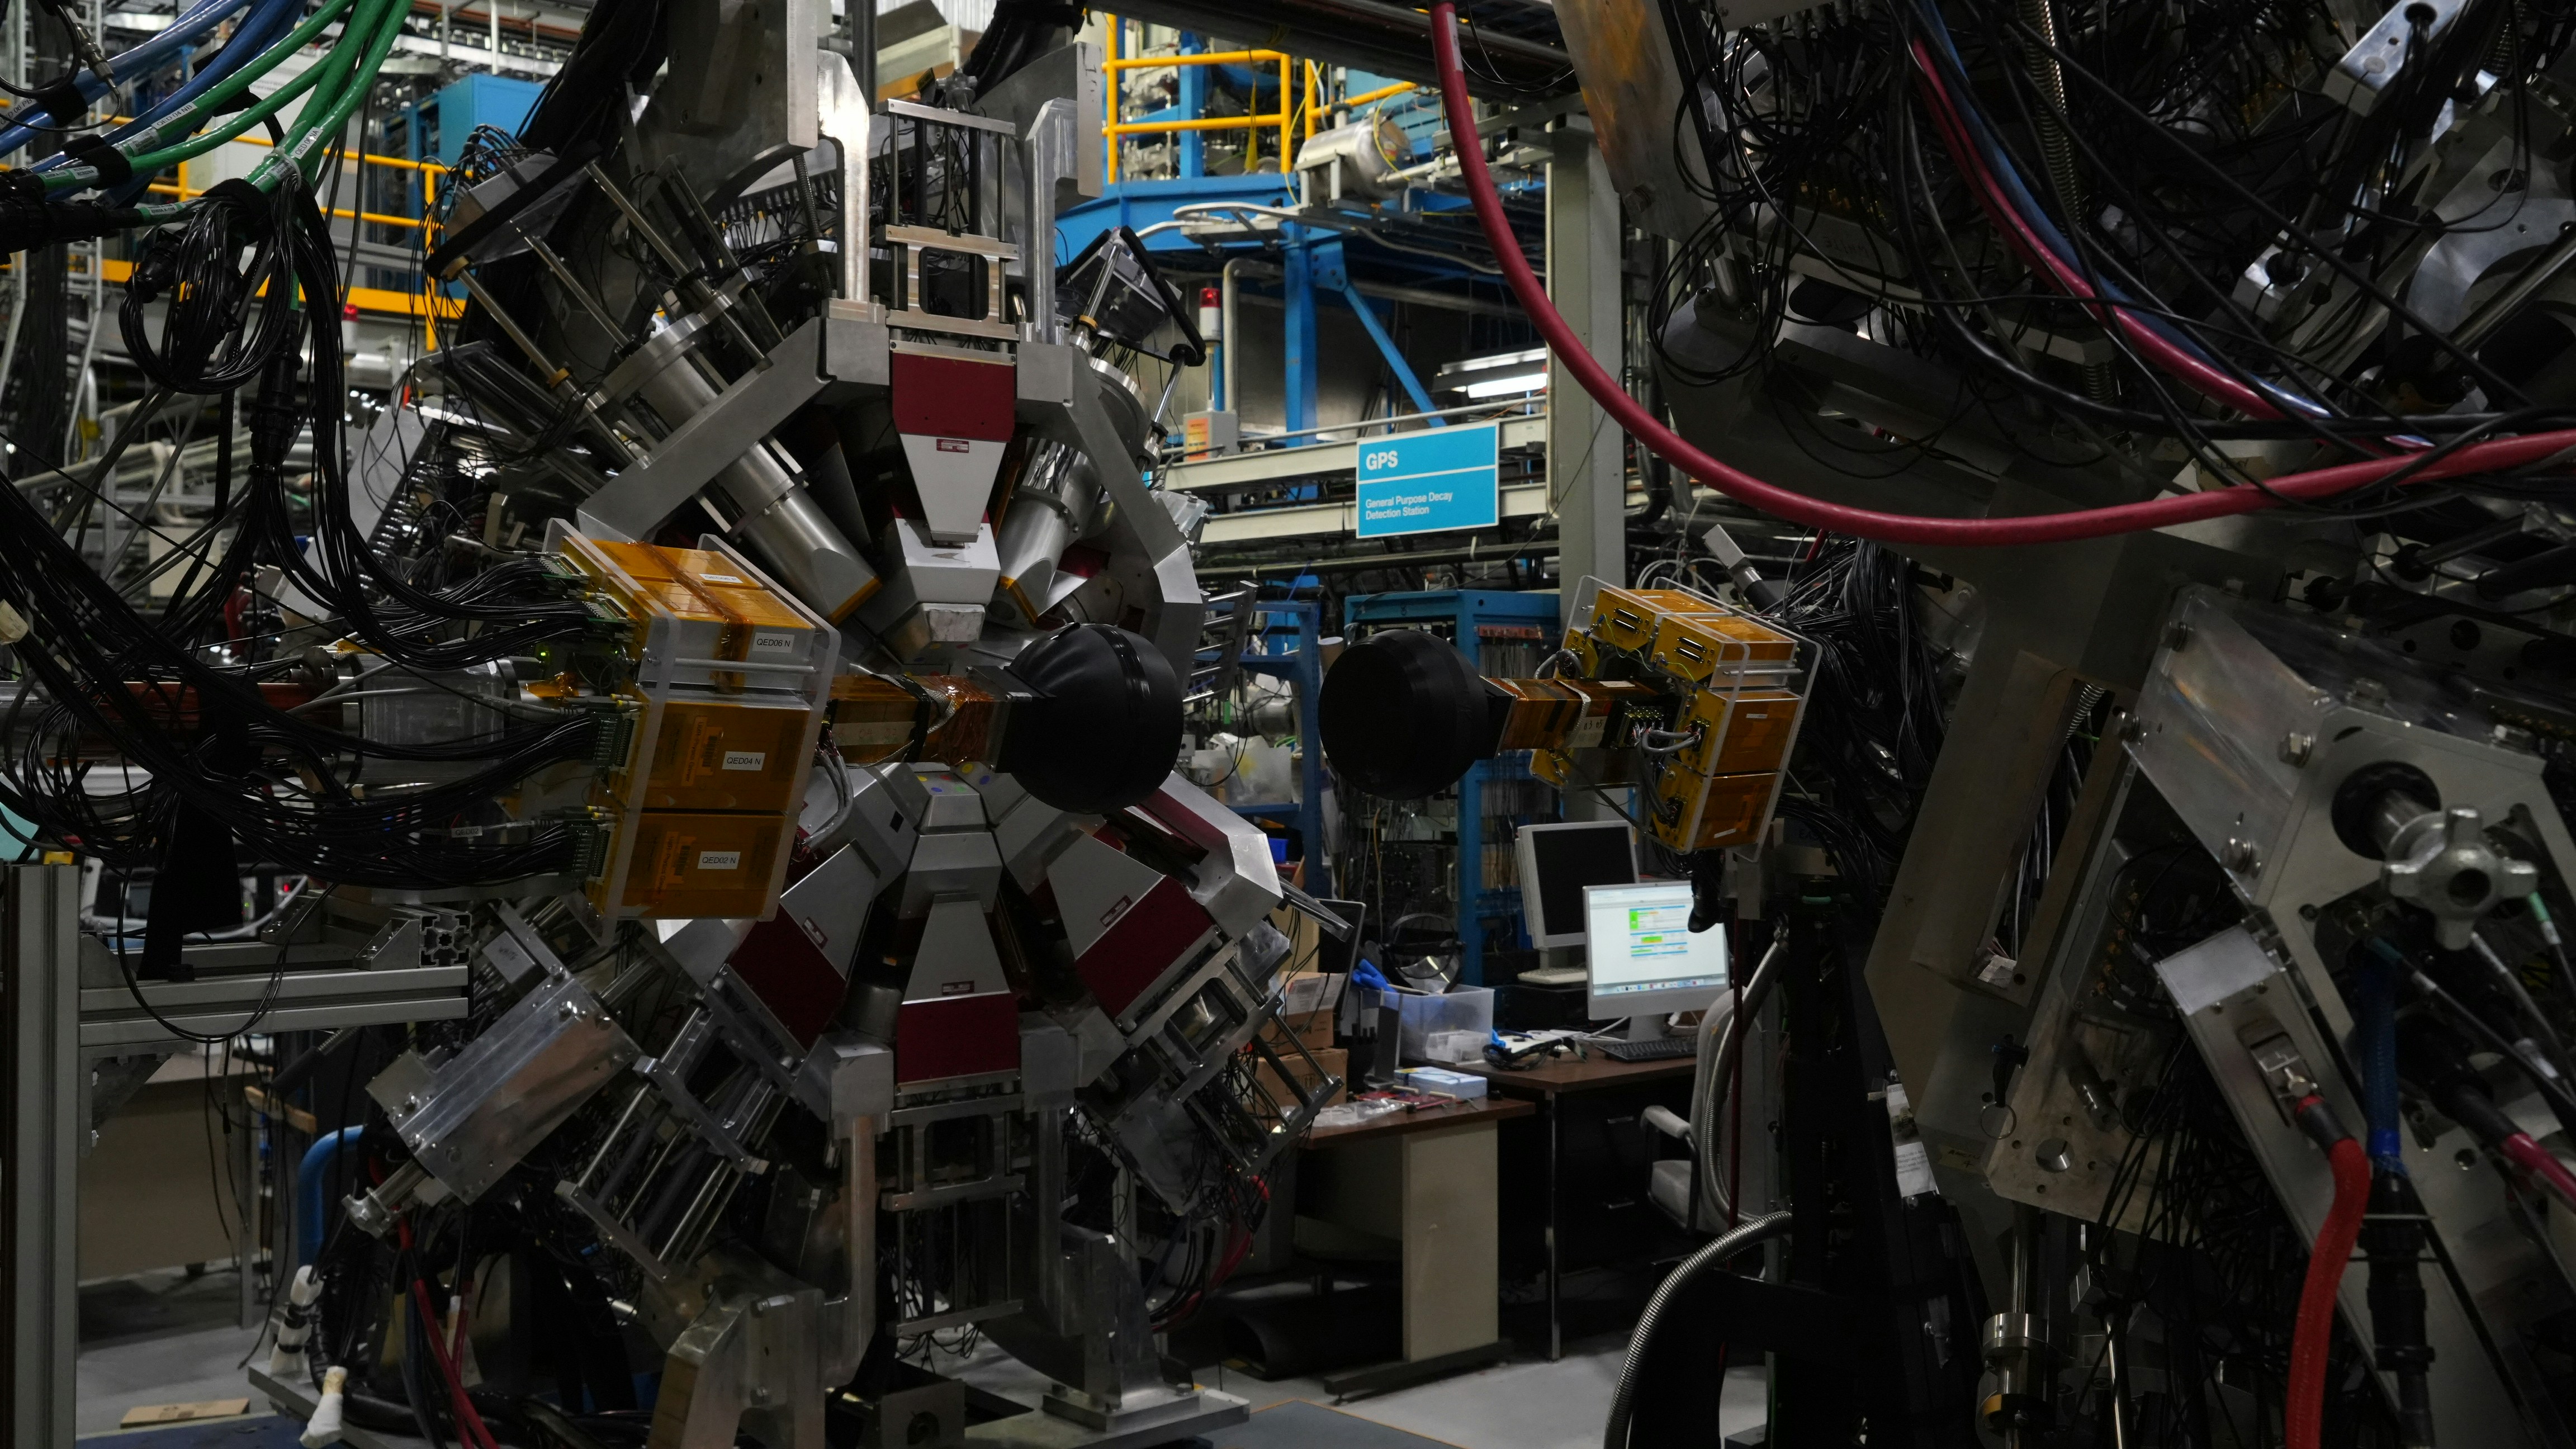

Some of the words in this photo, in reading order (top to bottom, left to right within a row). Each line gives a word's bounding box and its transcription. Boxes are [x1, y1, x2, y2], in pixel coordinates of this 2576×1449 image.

[157, 116, 173, 126] QED
[181, 105, 193, 113] NB
[295, 144, 307, 155] QED
[1366, 450, 1398, 470] GPS
[1366, 495, 1394, 508] General
[1396, 494, 1427, 506] Purpose
[1429, 491, 1453, 502] Decay
[1366, 509, 1401, 520] Detection
[1403, 506, 1429, 517] Station
[756, 638, 783, 647] QED06
